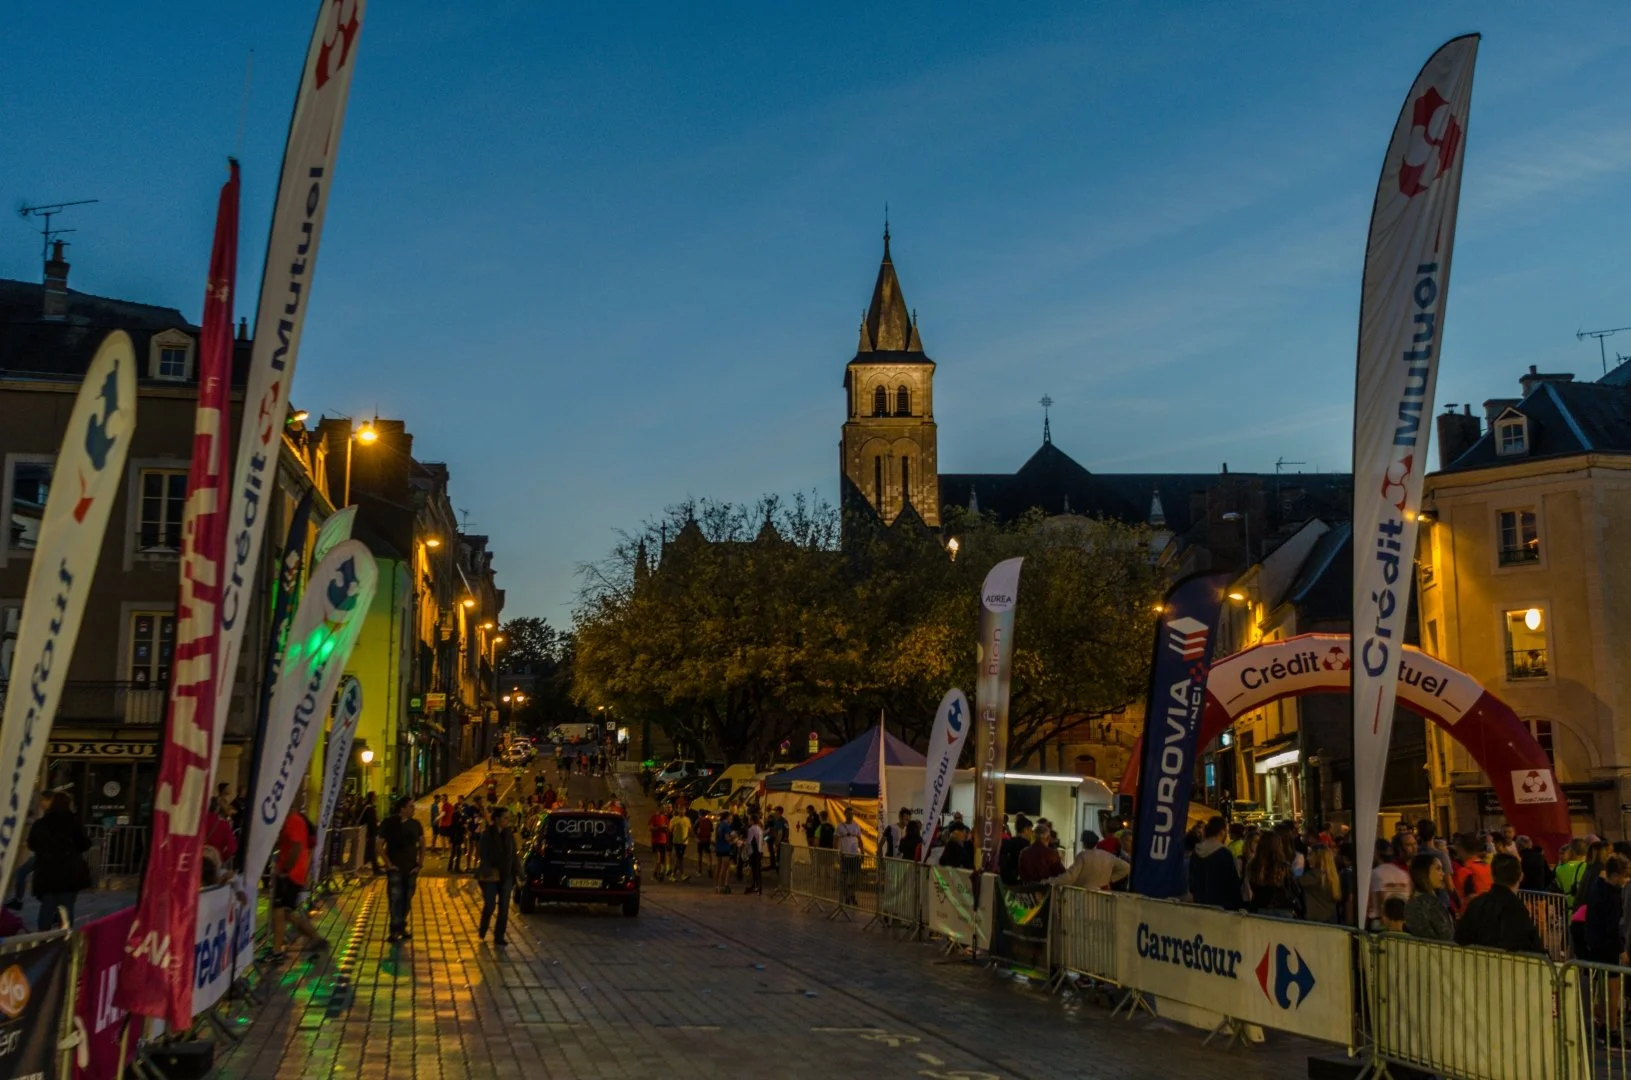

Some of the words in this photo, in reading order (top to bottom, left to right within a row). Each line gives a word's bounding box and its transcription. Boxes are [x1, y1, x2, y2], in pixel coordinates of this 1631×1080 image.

[222, 453, 267, 631] Crédit
[271, 167, 324, 370] Mutuel
[1362, 519, 1403, 678] Crédit
[1393, 262, 1438, 446] Mutuel
[985, 594, 1013, 603] ADREA
[988, 628, 1003, 676] Bien
[1240, 651, 1320, 690] Crédit
[1398, 660, 1448, 697] tuel
[0, 557, 74, 860] arrefour
[322, 735, 347, 829] Carrefour
[1149, 678, 1192, 861] EUROVIA
[555, 819, 607, 837] camp
[1136, 922, 1242, 979] Carrefour
